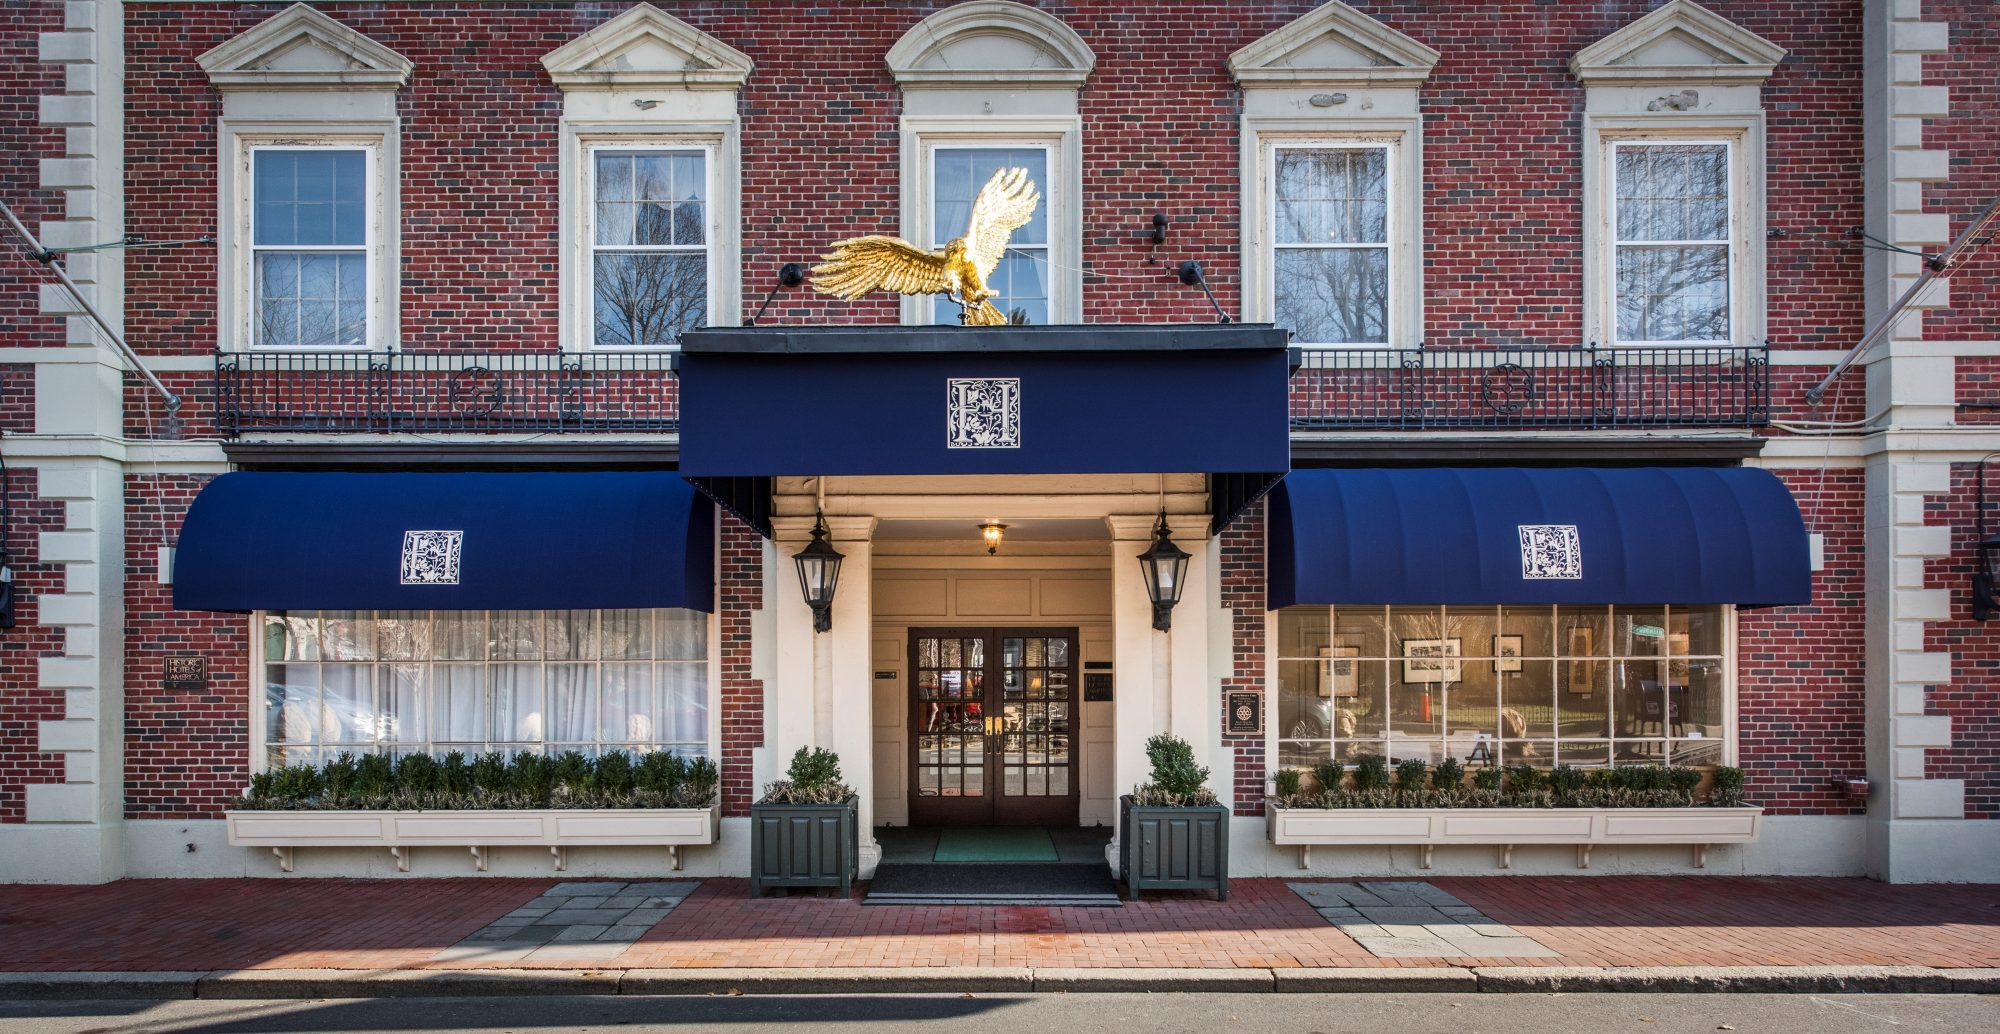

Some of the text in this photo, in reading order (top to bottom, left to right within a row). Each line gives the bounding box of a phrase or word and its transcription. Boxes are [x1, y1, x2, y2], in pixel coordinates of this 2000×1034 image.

[951, 383, 1017, 443] H
[405, 533, 461, 580] H
[1522, 528, 1579, 576] H
[169, 659, 200, 667] HISTORIC
